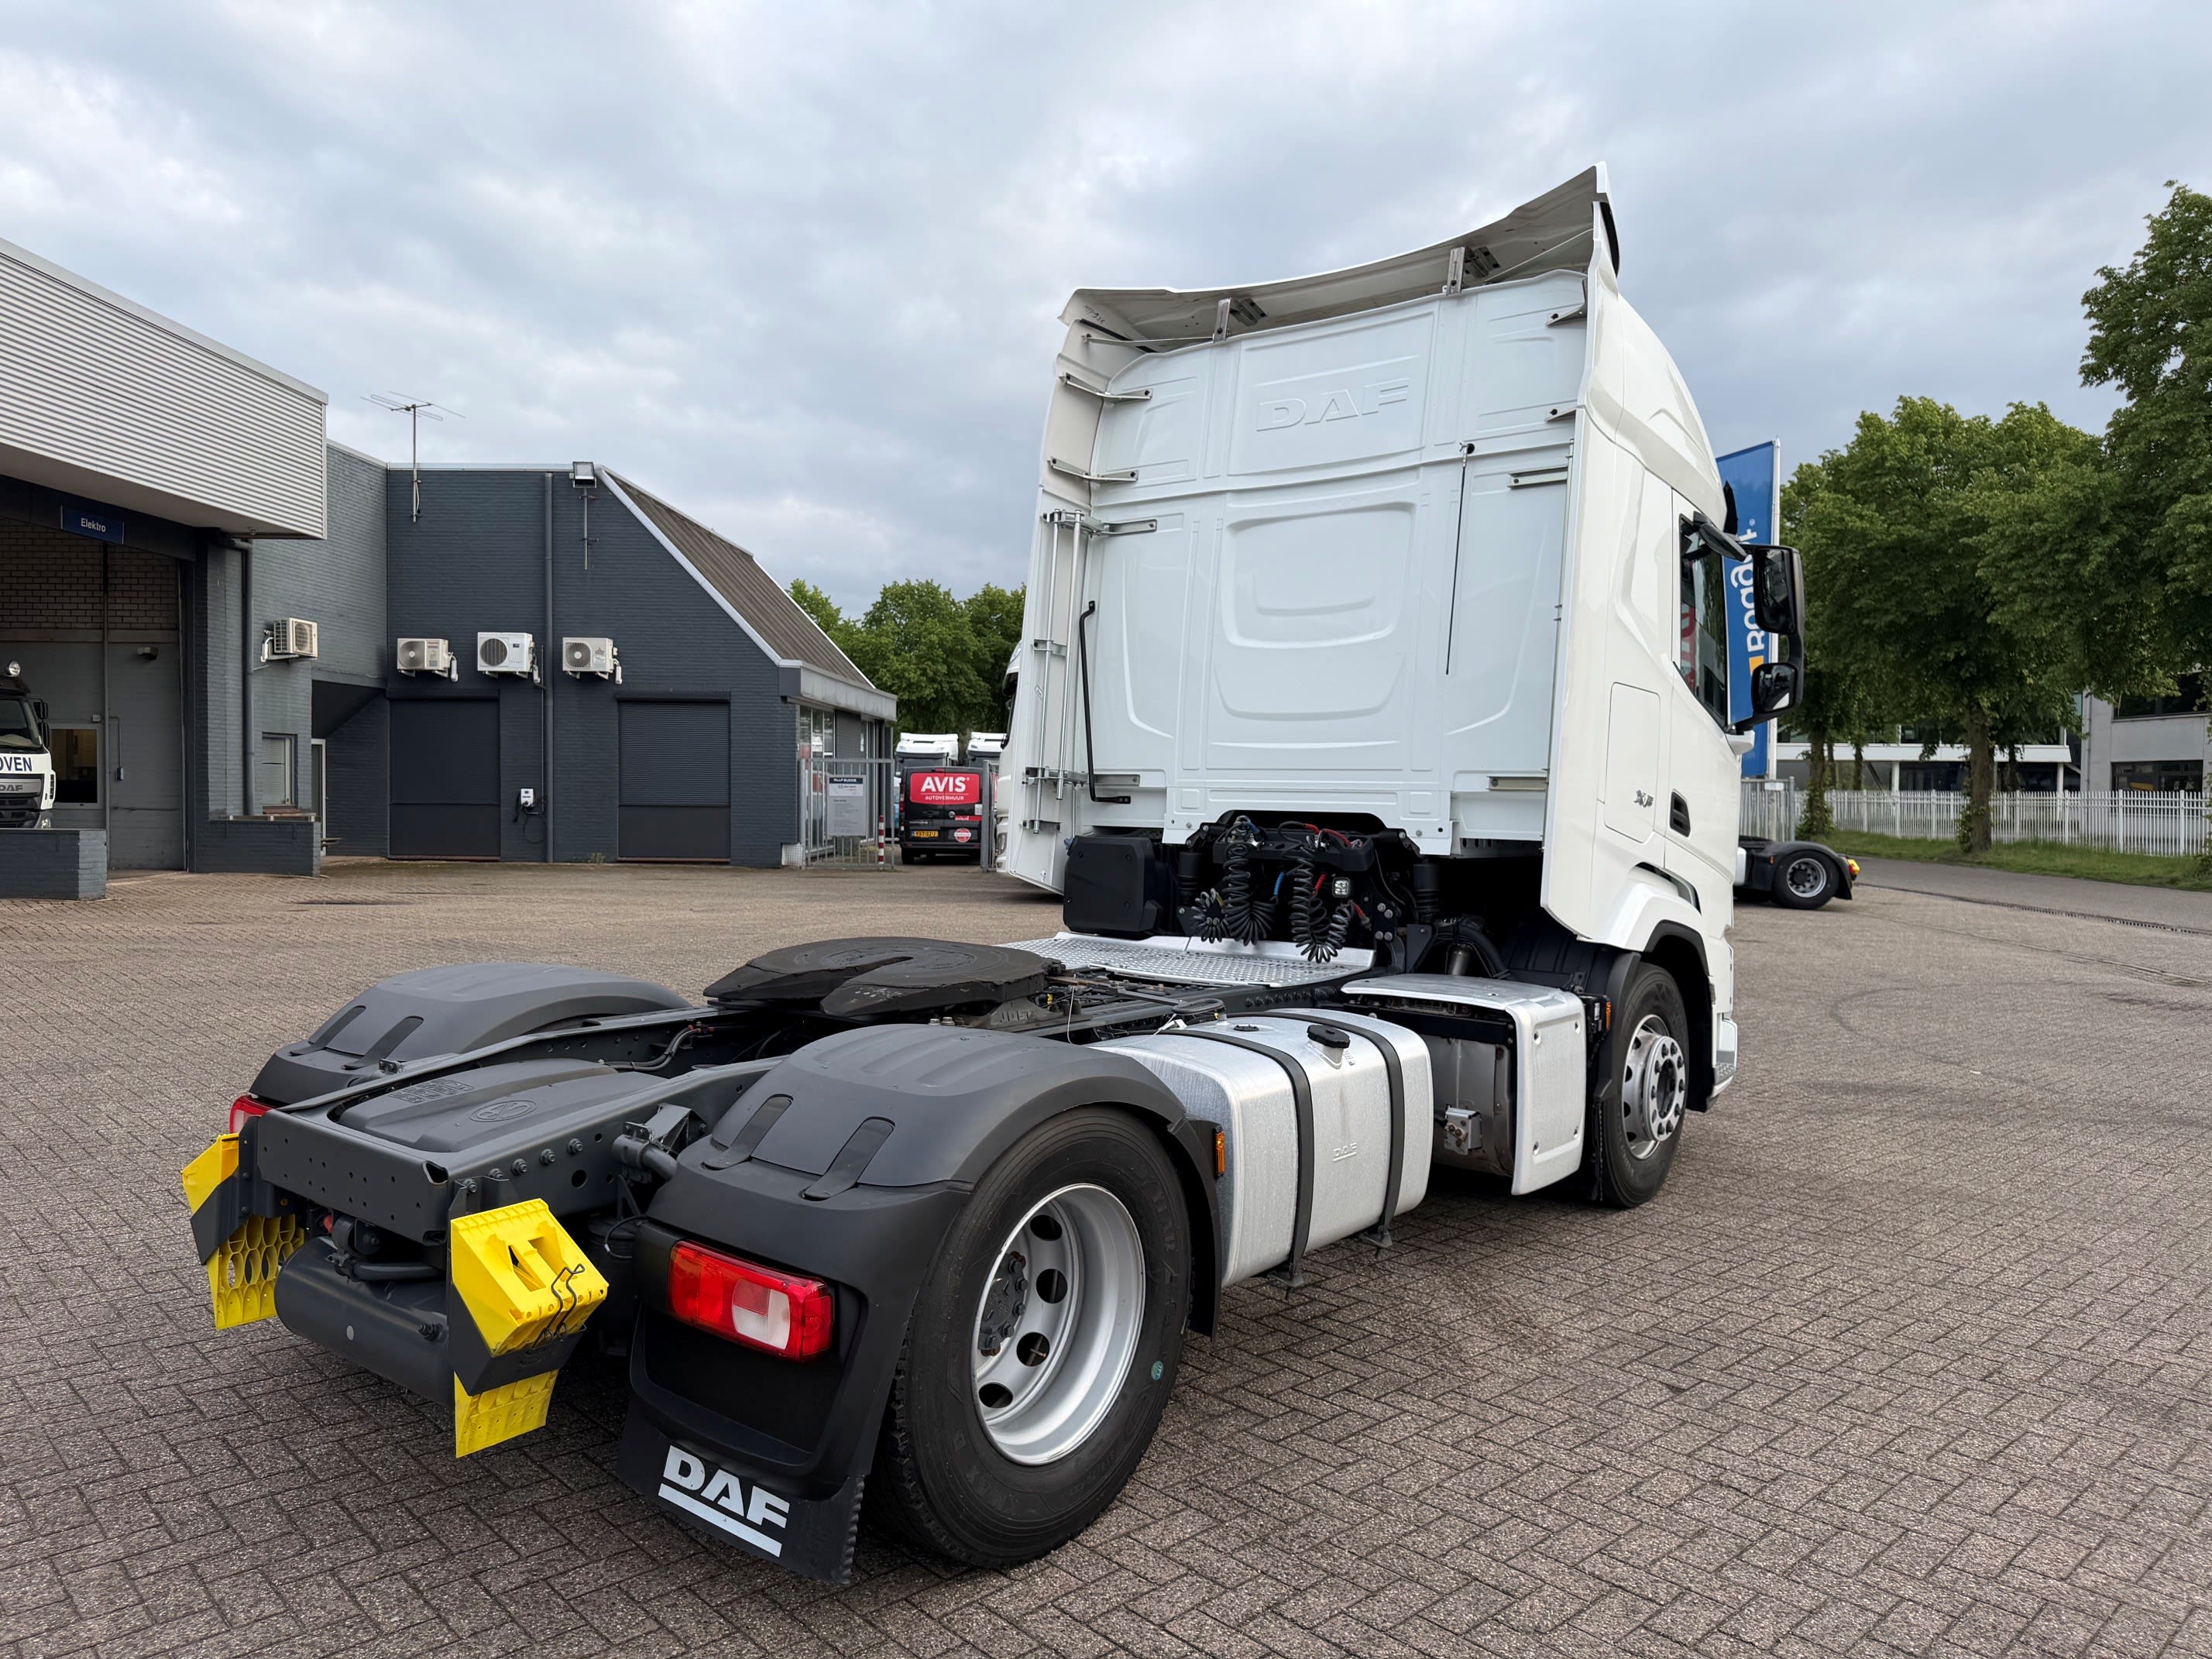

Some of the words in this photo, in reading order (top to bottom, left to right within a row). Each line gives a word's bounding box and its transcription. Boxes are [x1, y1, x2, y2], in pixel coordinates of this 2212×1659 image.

[1256, 377, 1410, 431] DAF
[81, 517, 107, 533] Elektro
[921, 776, 966, 793] AVIS
[663, 1445, 790, 1529] DAF
